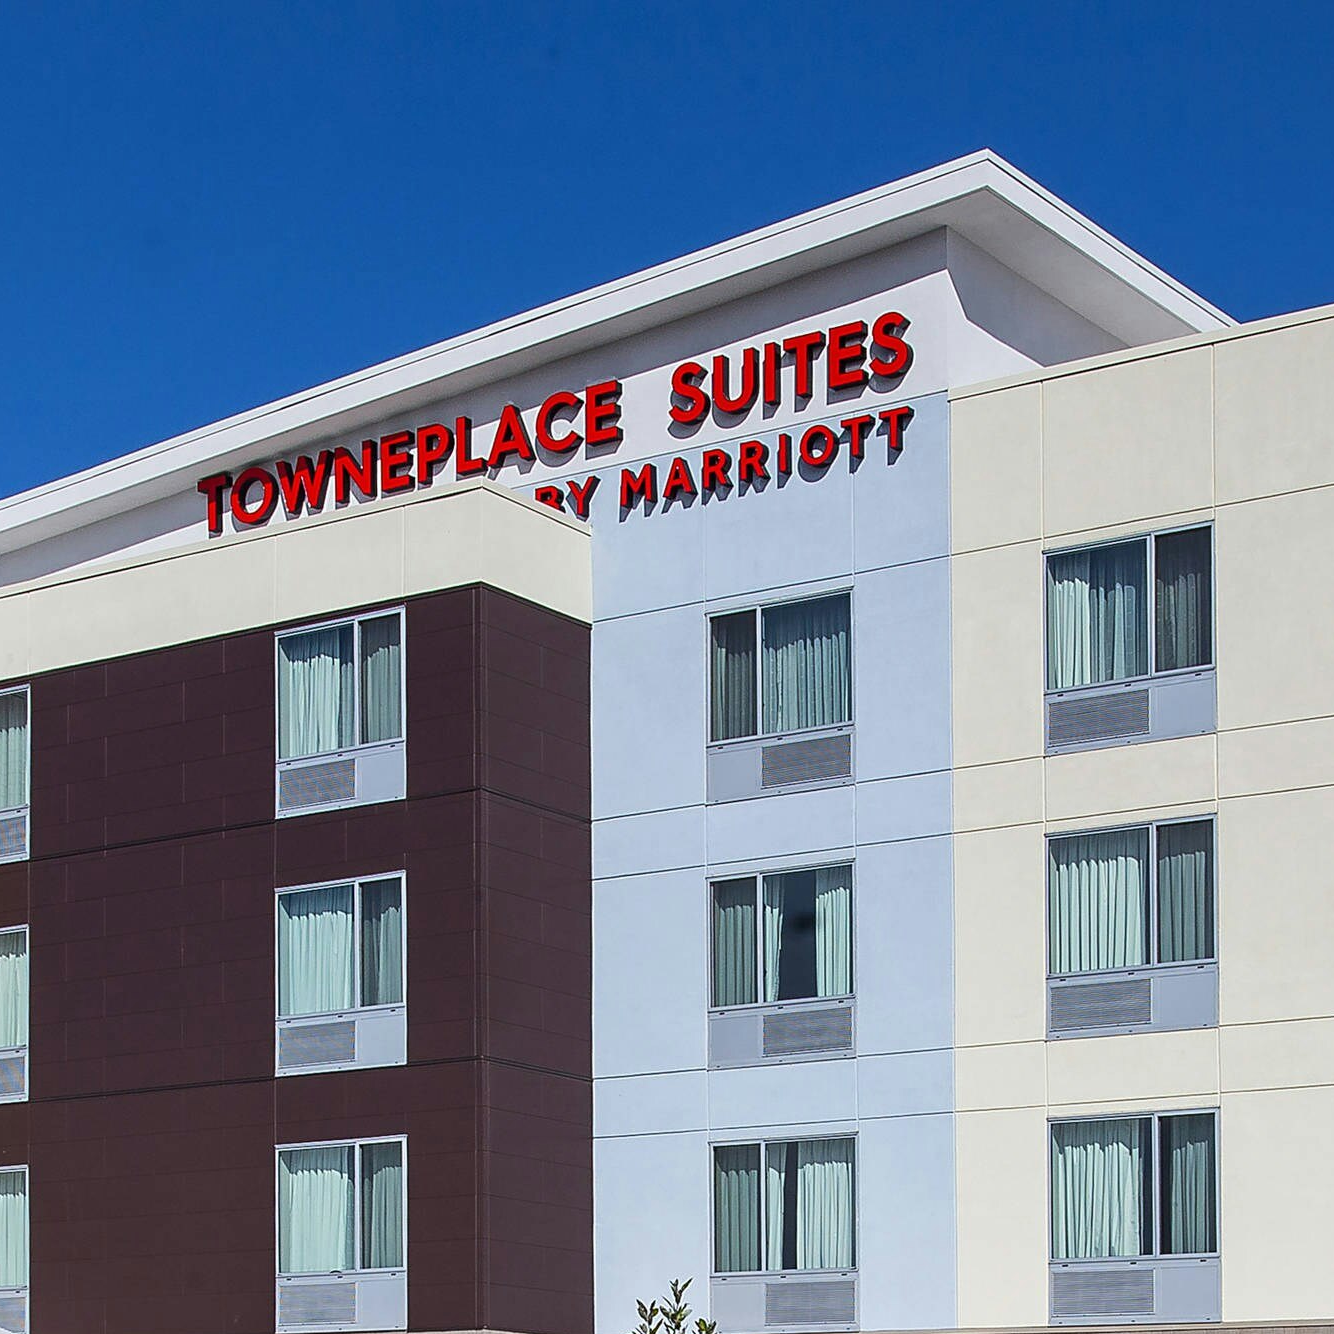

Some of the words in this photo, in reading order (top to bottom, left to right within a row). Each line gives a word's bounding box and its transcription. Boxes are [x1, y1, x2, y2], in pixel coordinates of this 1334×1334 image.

[198, 380, 622, 533] TOWNEPLACE
[668, 312, 911, 424] SUITES
[620, 406, 914, 511] MARRIOTT
